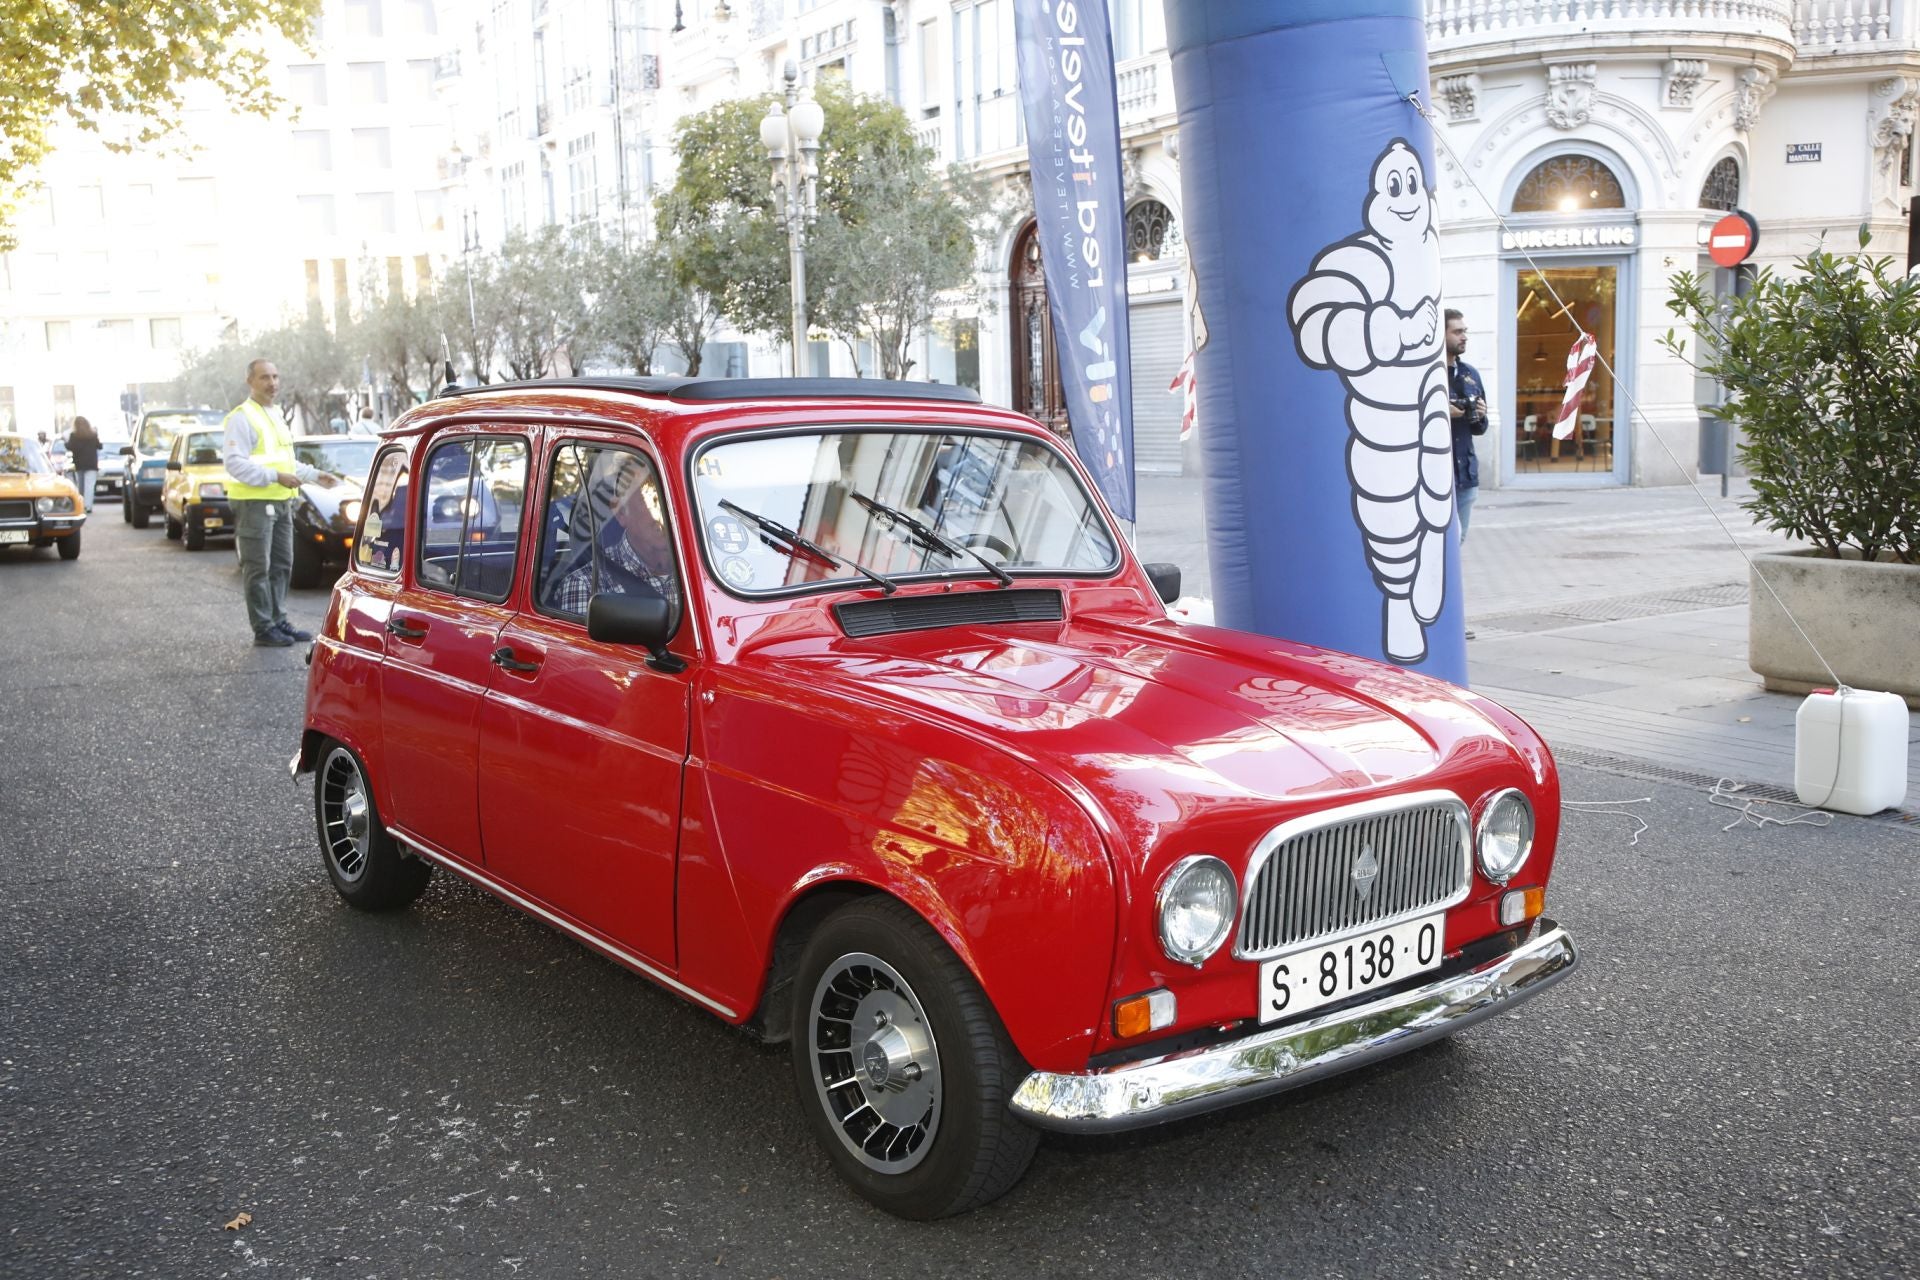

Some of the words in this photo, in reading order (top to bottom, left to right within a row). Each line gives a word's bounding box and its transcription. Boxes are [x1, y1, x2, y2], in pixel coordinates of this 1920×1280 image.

[1797, 143, 1821, 151] CALLE
[1788, 153, 1820, 162] MANTILLA
[1502, 228, 1582, 249] BURGER
